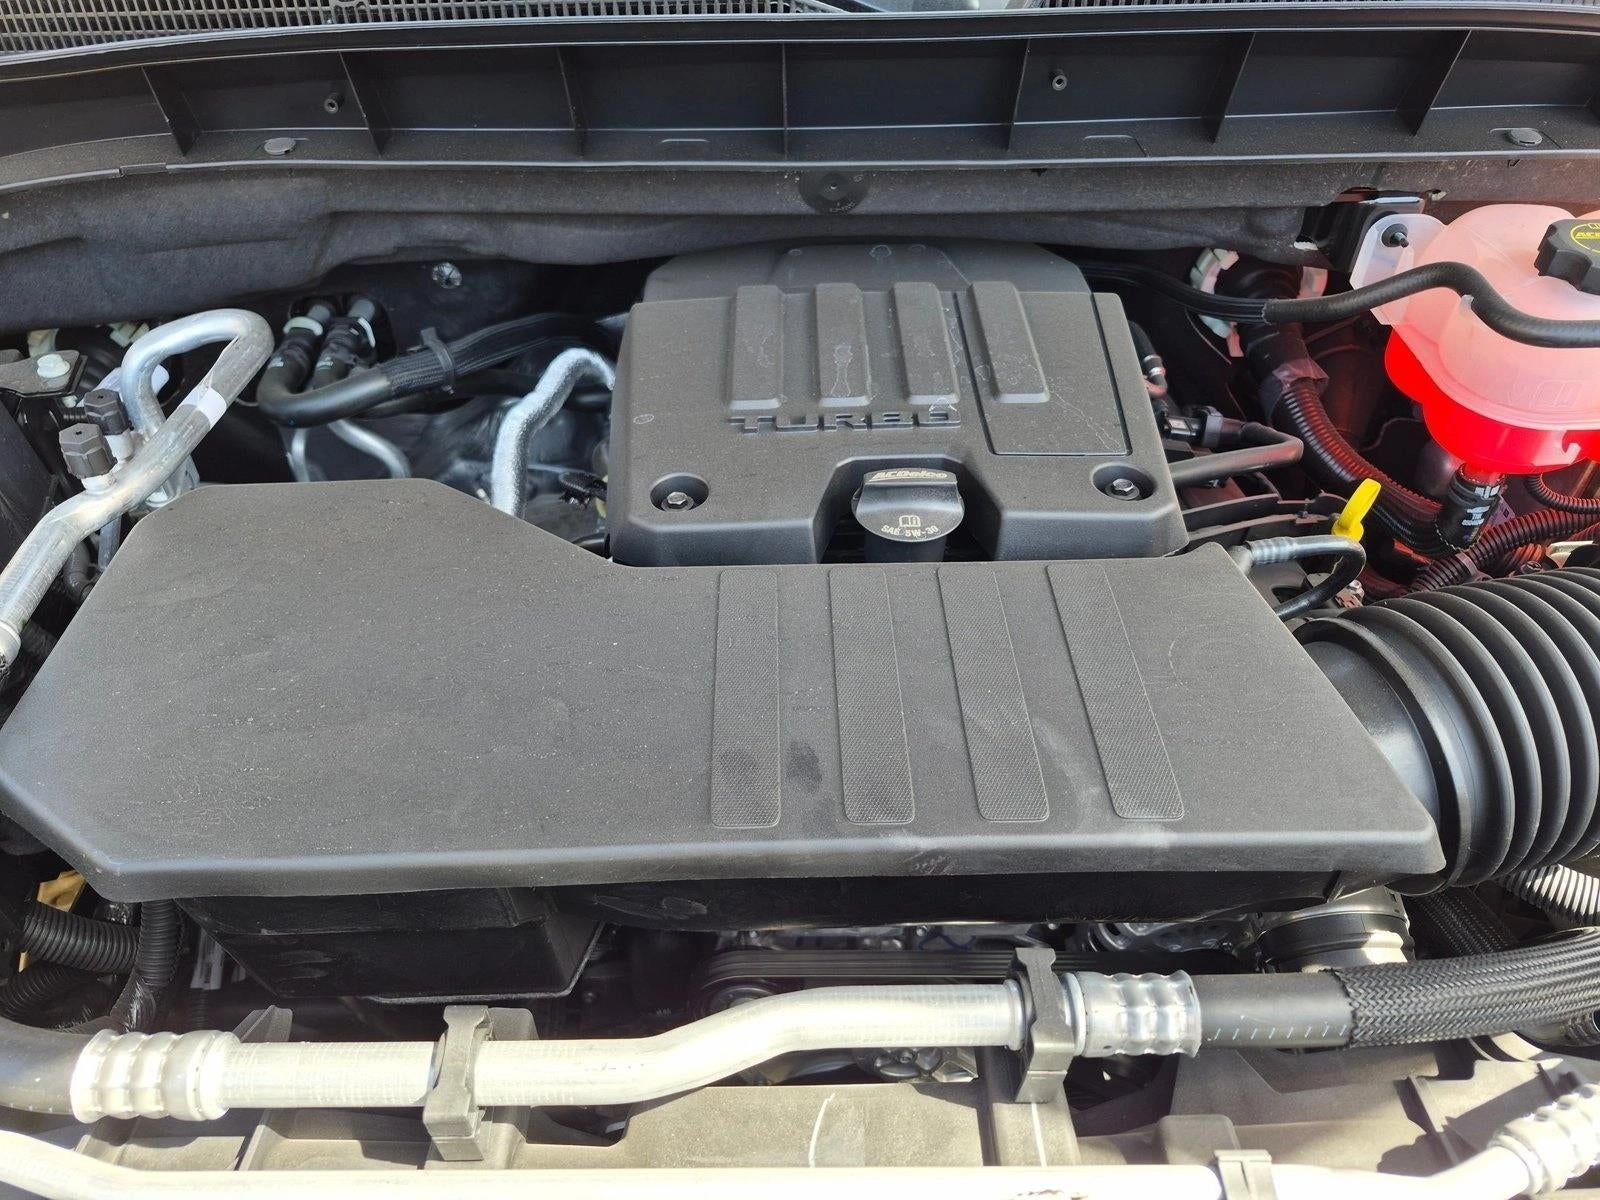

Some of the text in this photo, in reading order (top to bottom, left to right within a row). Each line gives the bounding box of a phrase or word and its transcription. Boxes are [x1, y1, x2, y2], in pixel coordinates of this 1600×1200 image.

[729, 410, 961, 434] TURBO
[869, 470, 948, 480] ACDelco
[881, 525, 939, 537] SAE 5W-30
